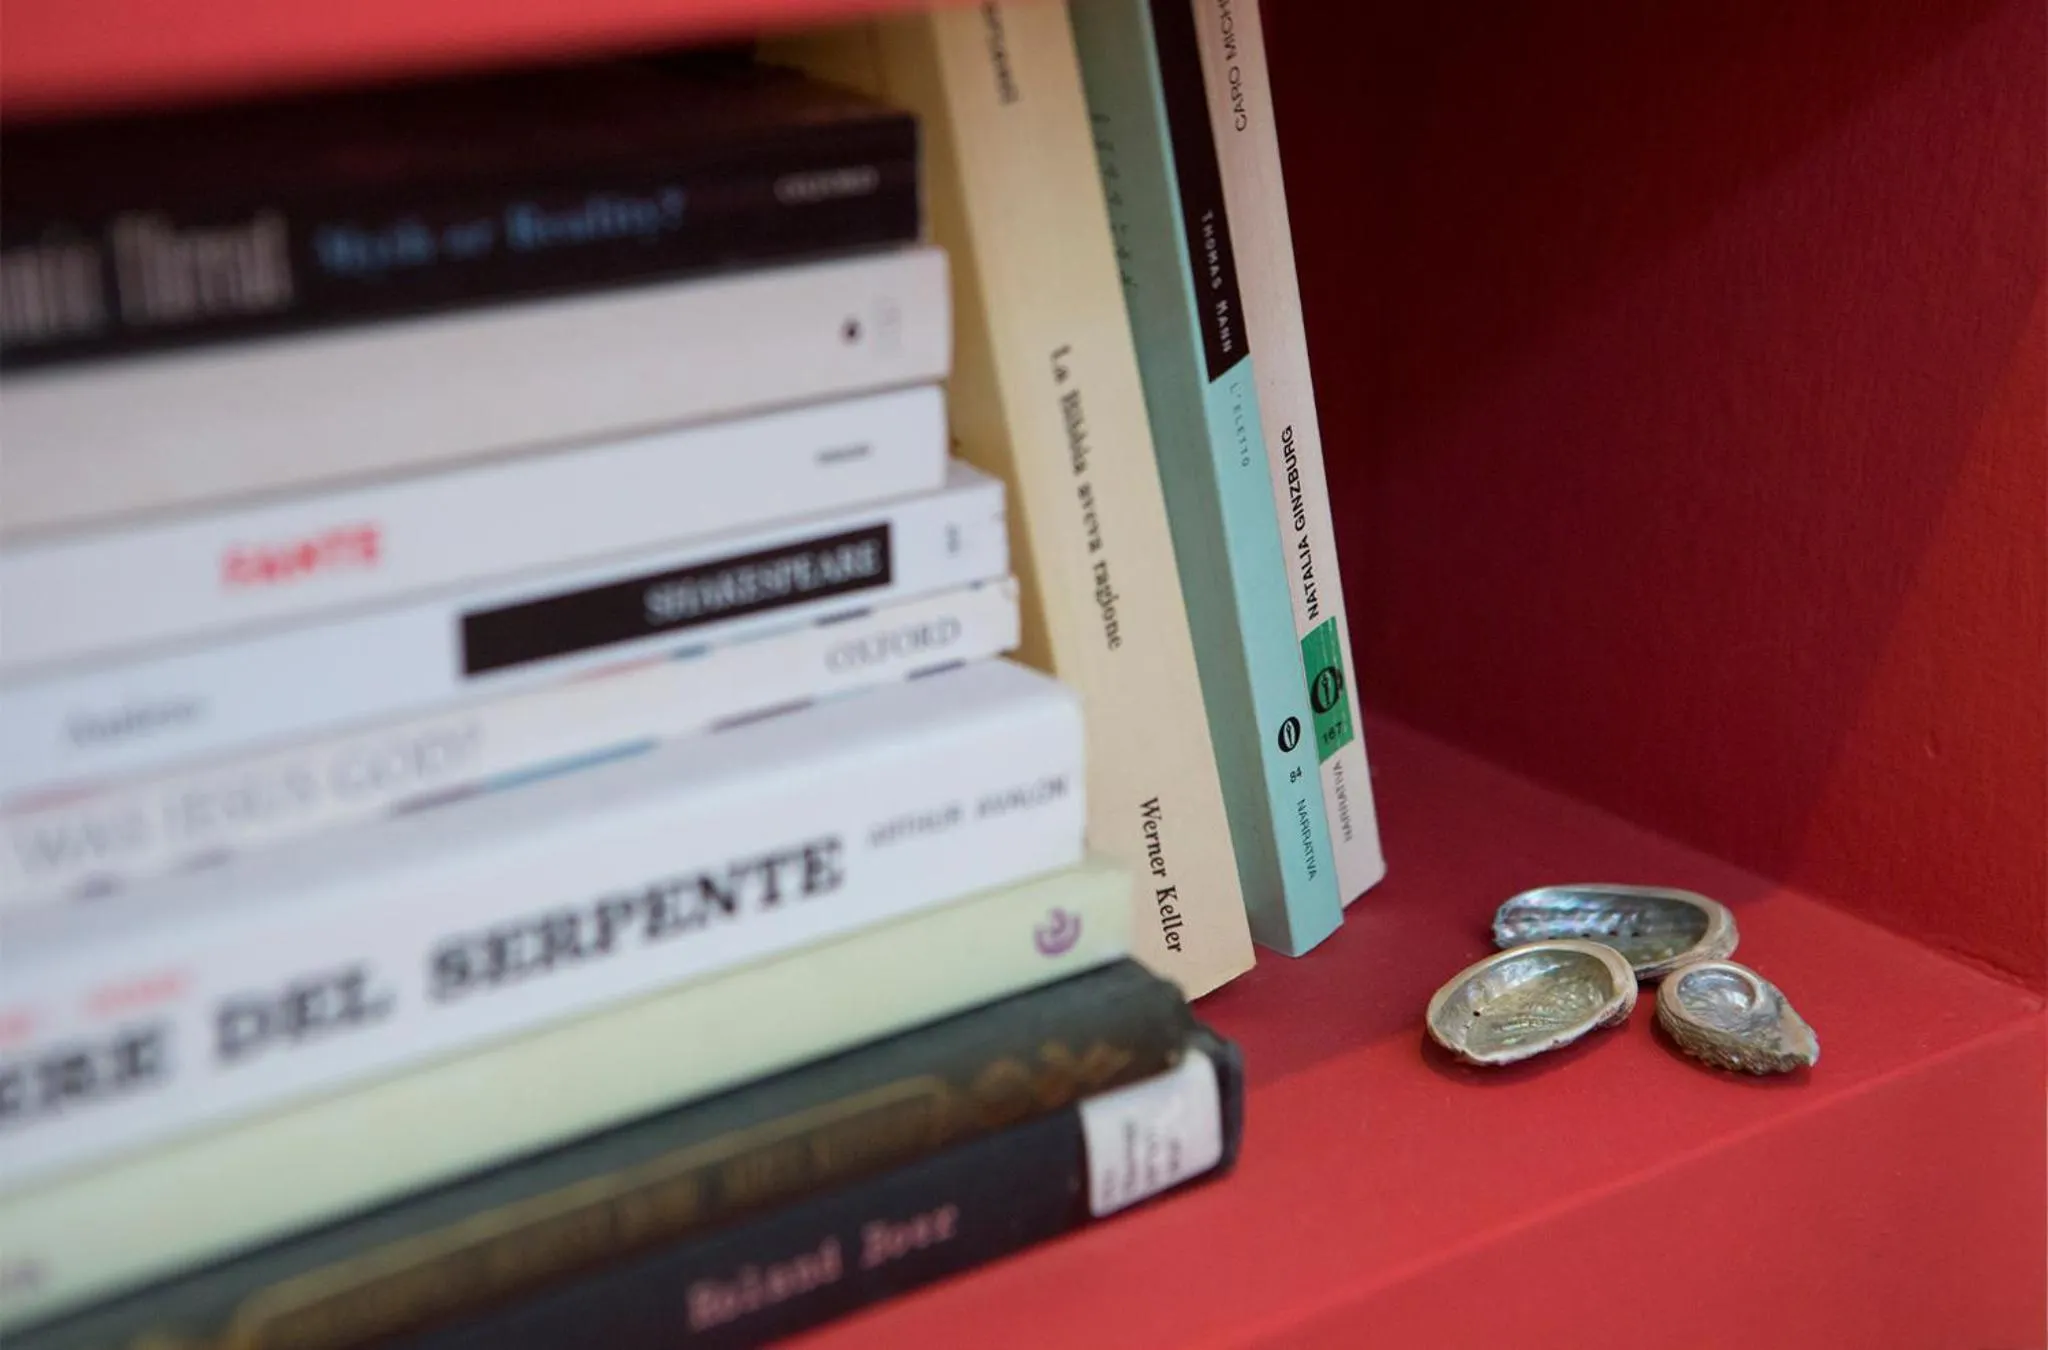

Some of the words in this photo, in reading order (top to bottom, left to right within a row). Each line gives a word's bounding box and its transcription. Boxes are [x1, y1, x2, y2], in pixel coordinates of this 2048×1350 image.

[1216, 0, 1239, 60] MICH
[1227, 65, 1248, 132] CARO
[1202, 210, 1223, 290] THOMAS
[1216, 300, 1232, 352] MANN
[1051, 344, 1072, 384] La
[1092, 559, 1121, 651] ragione
[1281, 424, 1306, 532] GINZBURG
[644, 537, 884, 625] SHAKESPEARE
[1297, 534, 1320, 621] NATALIA
[825, 614, 963, 676] OXFORD
[1290, 766, 1302, 783] 84
[1321, 721, 1344, 744] 167
[1140, 797, 1167, 878] Werner
[1156, 884, 1183, 953] Keller
[1296, 799, 1317, 881] NARRATIVA
[210, 960, 396, 1066] DEL
[428, 836, 845, 1004] SERPENTE
[689, 1236, 843, 1331] Roland
